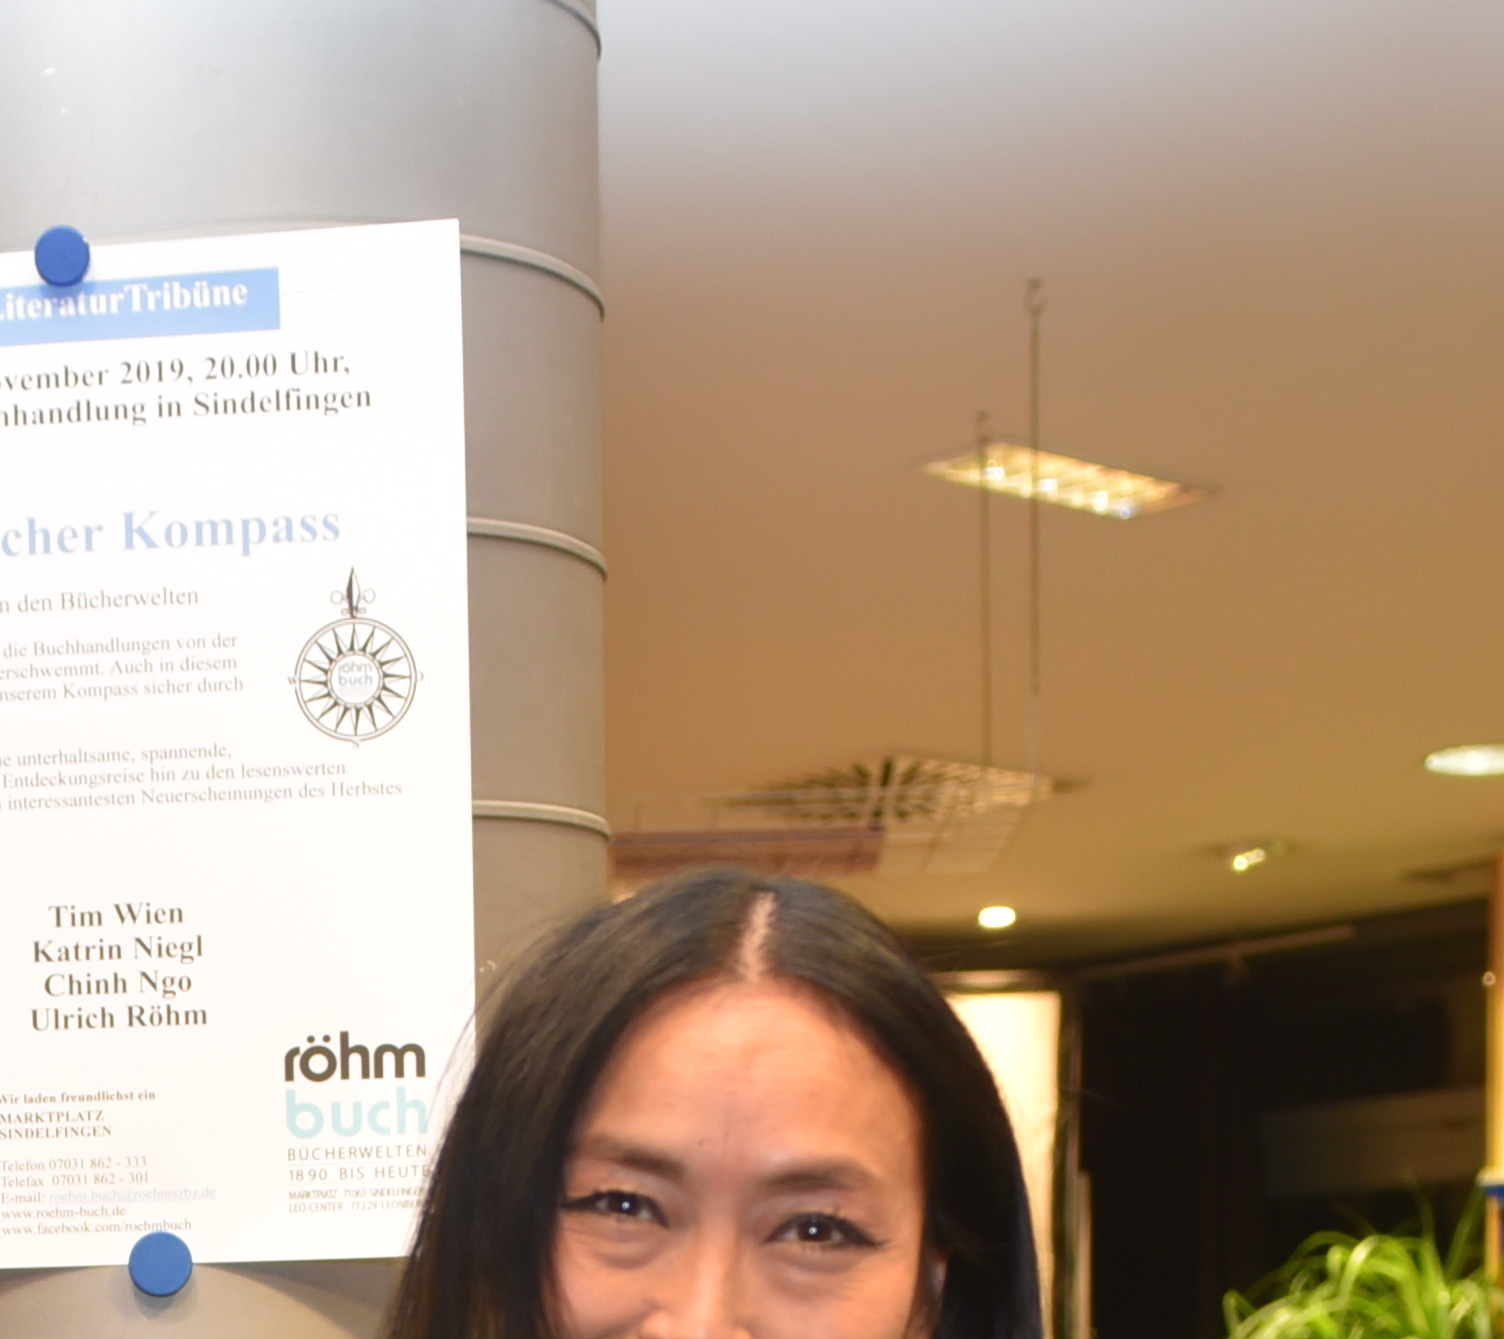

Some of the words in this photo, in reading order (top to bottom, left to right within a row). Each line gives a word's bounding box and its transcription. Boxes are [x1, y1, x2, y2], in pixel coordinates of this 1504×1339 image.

[121, 360, 193, 385] 2019,
[206, 355, 277, 380] 20.00
[290, 351, 349, 375] Uhr,
[158, 395, 181, 417] in
[194, 388, 371, 415] Sindelfingen
[123, 511, 340, 557] Kompass
[17, 593, 52, 613] den
[61, 587, 199, 610] Bücherwelten
[33, 637, 170, 658] Buchhandlungen
[110, 656, 153, 675] Auch
[180, 656, 237, 671] diesem
[63, 683, 138, 702] Kompass
[144, 679, 192, 695] sicher
[197, 676, 244, 692] durch
[17, 748, 135, 767] unterhaltsame,
[141, 742, 232, 765] spannende,
[3, 768, 144, 790] Entdeckungsreise
[241, 763, 346, 778] lesenswerten
[8, 793, 135, 810] interessantesten
[141, 786, 293, 805] Neuerscheinungen
[331, 780, 402, 797] Herbstes
[49, 905, 103, 928] Tim
[114, 902, 183, 924] Wien
[34, 938, 122, 962] Katrin
[135, 935, 202, 963] Niegl
[44, 972, 127, 996] Chinh
[140, 971, 192, 998] Ngo
[32, 1007, 115, 1031] Ulrich
[128, 1004, 207, 1028] Röhm
[285, 1031, 426, 1082] röhm
[23, 1093, 56, 1103] laden
[61, 1091, 134, 1102] freundlichst
[138, 1091, 156, 1100] ein
[0, 1110, 104, 1124] MARKTPLATZ
[285, 1086, 428, 1139] buch
[0, 1125, 111, 1140] SINDELFINGEN
[0, 1159, 45, 1171] Telefon
[48, 1157, 84, 1170] 07031
[90, 1157, 112, 1169] 862
[125, 1155, 147, 1168] 333
[287, 1144, 428, 1161] BÜCHERWELTEN
[0, 1175, 45, 1188] Telefax
[51, 1173, 88, 1186] 07031
[93, 1172, 116, 1185] 862
[129, 1172, 148, 1183] 301
[289, 1168, 328, 1182] 1890
[339, 1166, 365, 1180] BIS
[375, 1164, 429, 1178] HEUTE
[1, 1191, 45, 1204] E-mail:
[1, 1203, 126, 1218] www.roehm-buch.de
[2, 1218, 192, 1235] www.facebook.com/roehmbuch
